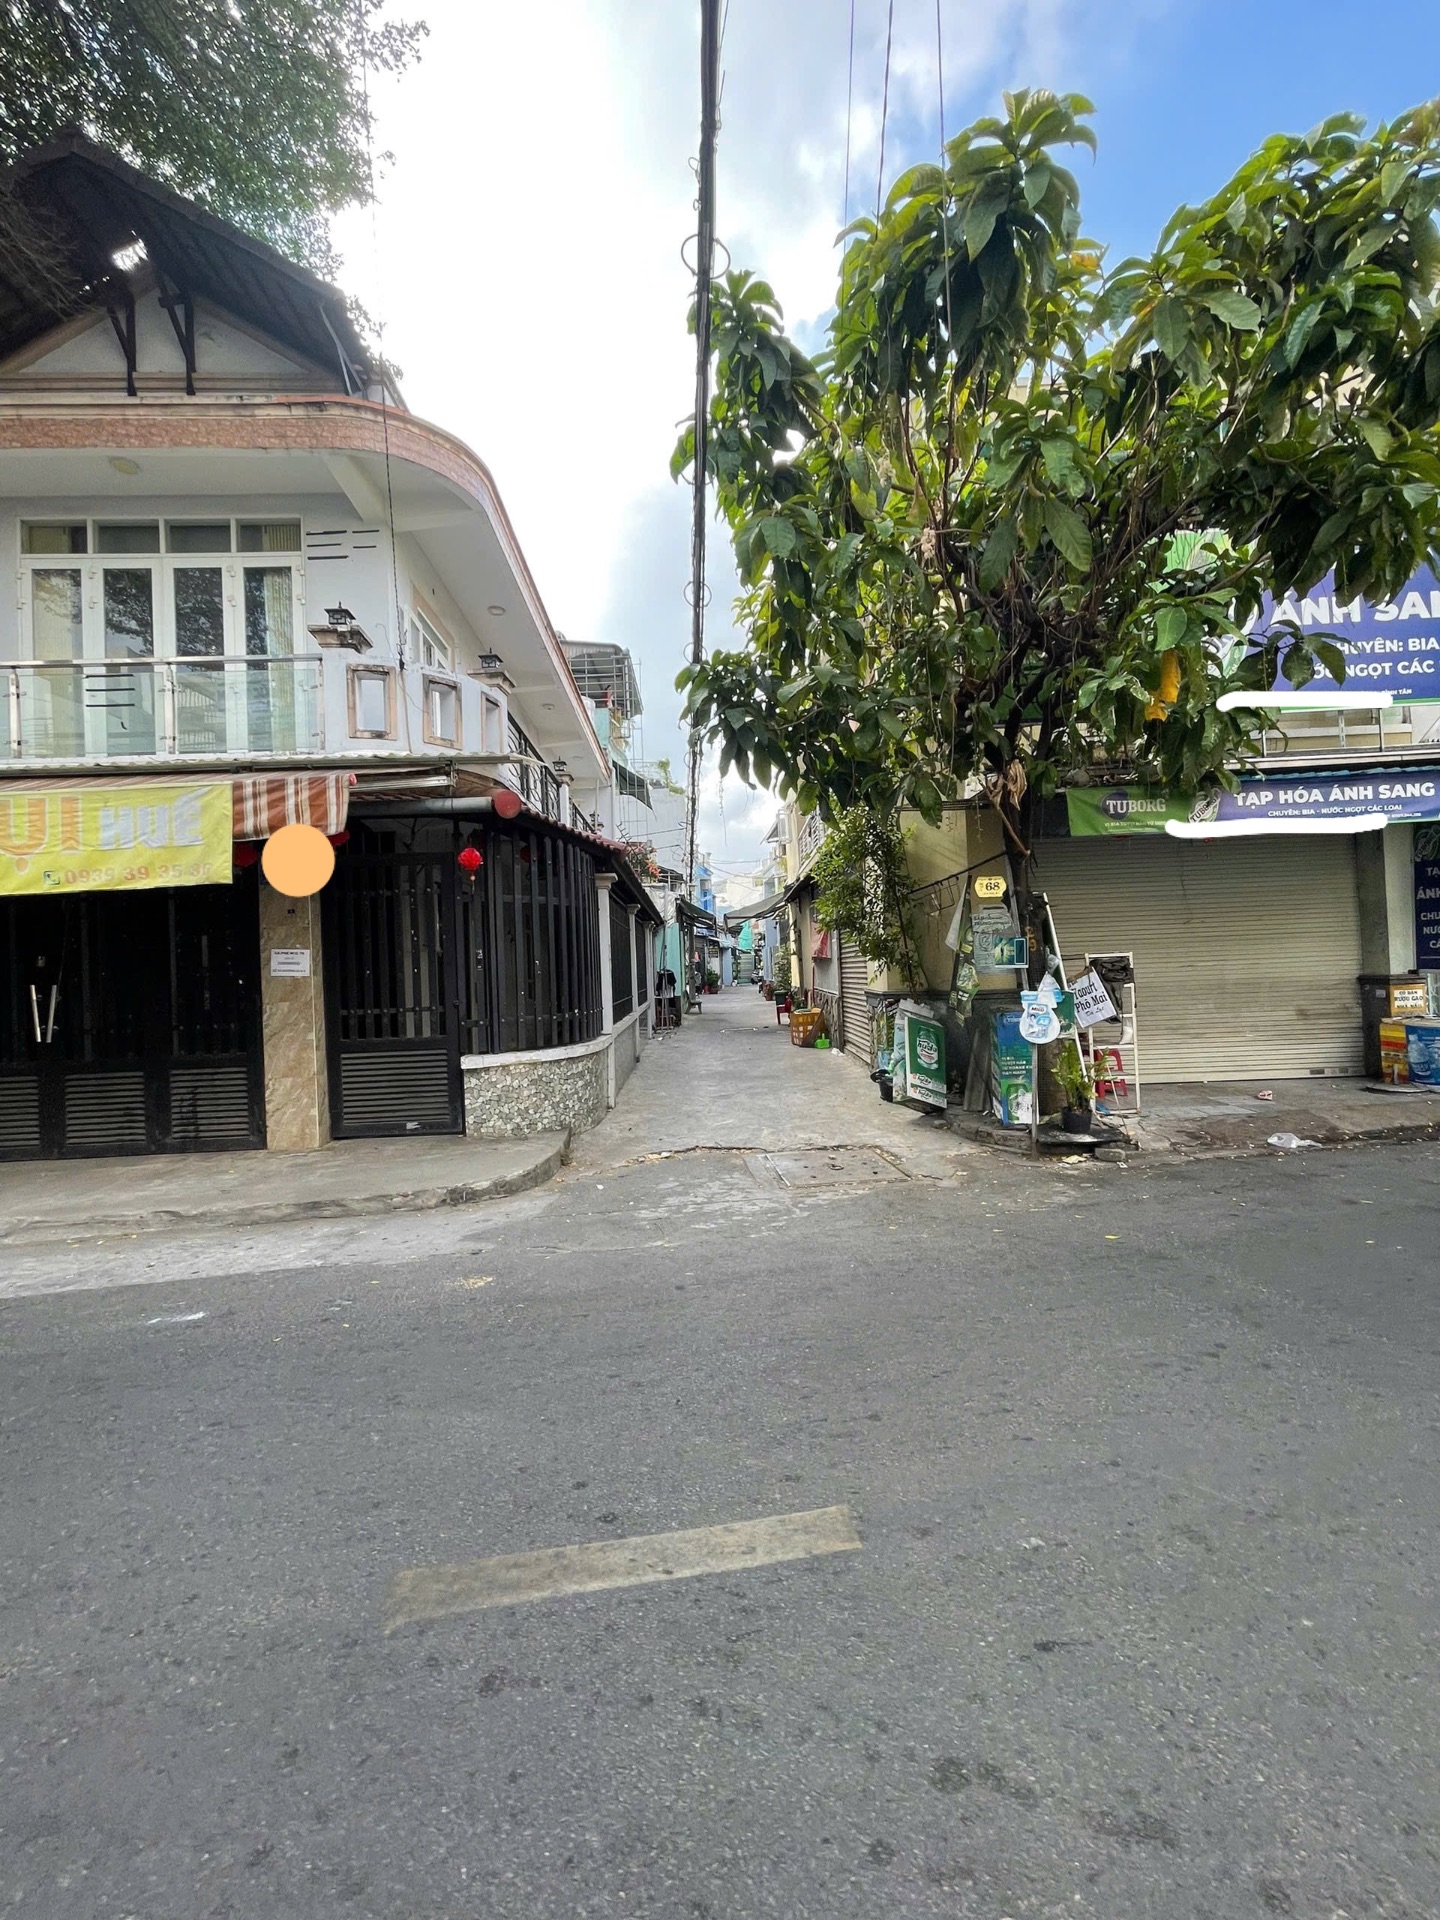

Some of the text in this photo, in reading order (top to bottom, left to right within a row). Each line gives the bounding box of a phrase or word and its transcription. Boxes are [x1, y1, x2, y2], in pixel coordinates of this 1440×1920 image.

[1270, 591, 1361, 627] ÁNH
[1408, 637, 1440, 651] BIA
[1398, 658, 1435, 675] CÁC
[1234, 782, 1435, 809] TẠP HÓA ÁNH SANG
[1106, 798, 1166, 814] TUBORG
[123, 865, 151, 881] 39
[985, 881, 1000, 891] 68
[1074, 991, 1108, 1013] Phô Mai
